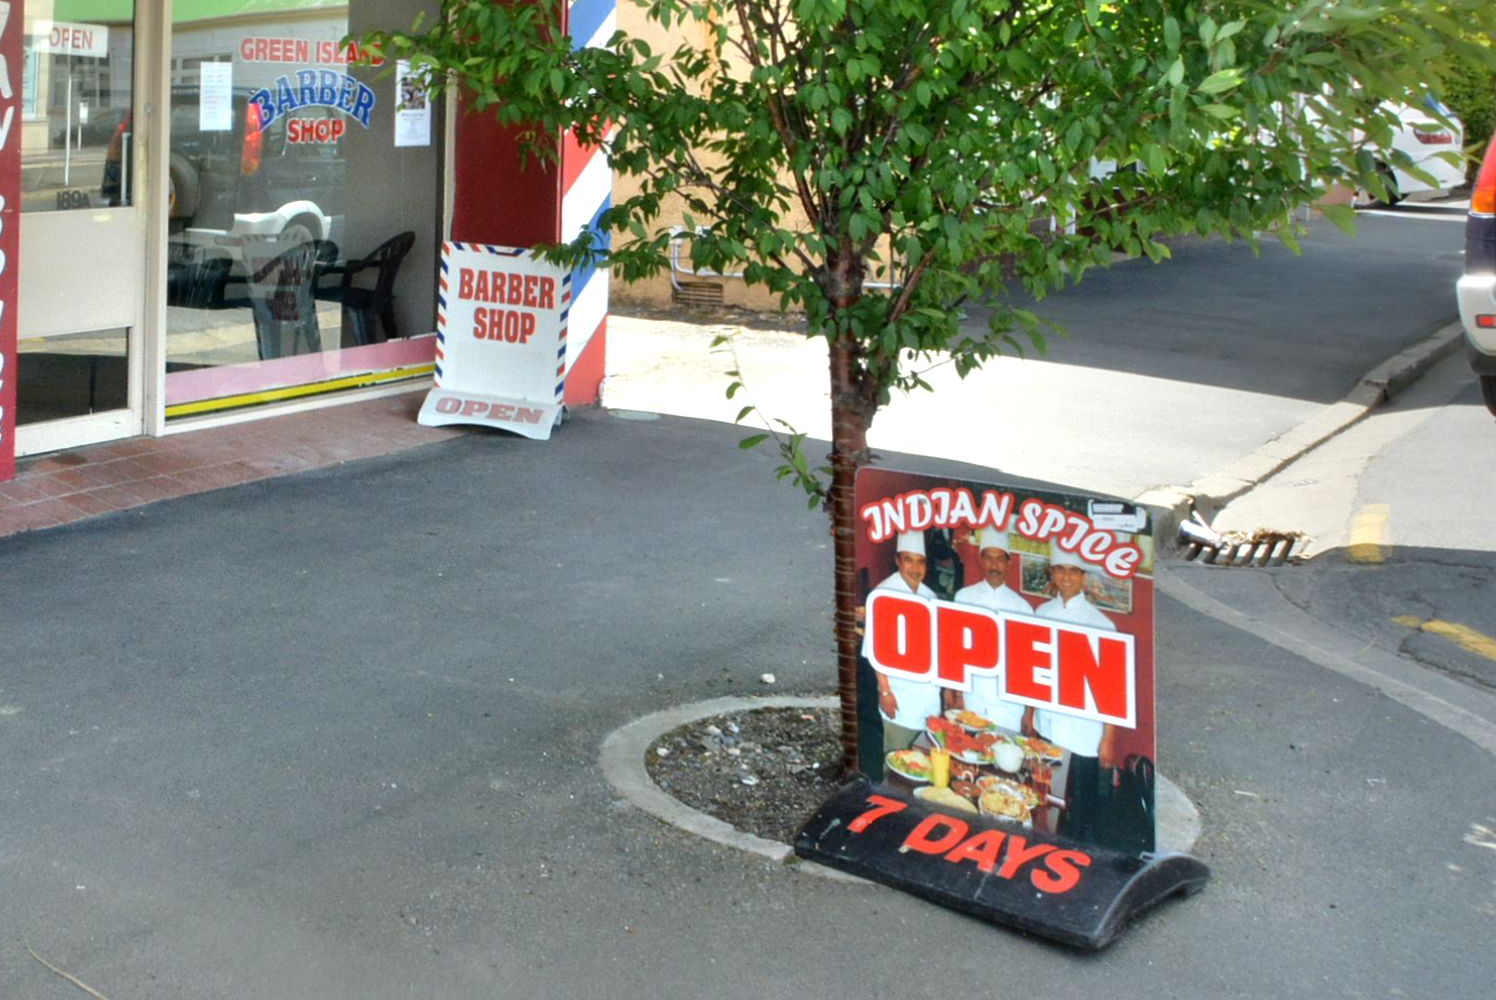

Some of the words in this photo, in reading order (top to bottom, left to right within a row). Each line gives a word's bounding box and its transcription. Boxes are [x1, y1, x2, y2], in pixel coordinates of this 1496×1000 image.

[48, 26, 94, 50] OPEN
[240, 37, 310, 64] GREEN
[249, 68, 376, 132] BARBER
[286, 117, 346, 144] SHOP
[457, 267, 557, 309] BARBER
[472, 305, 537, 344] SHOP
[434, 396, 546, 425] OPEN
[1019, 502, 1140, 577] SPICE
[872, 594, 1127, 720] OPEN
[846, 795, 907, 834] 7
[905, 813, 1092, 893] DAYS
